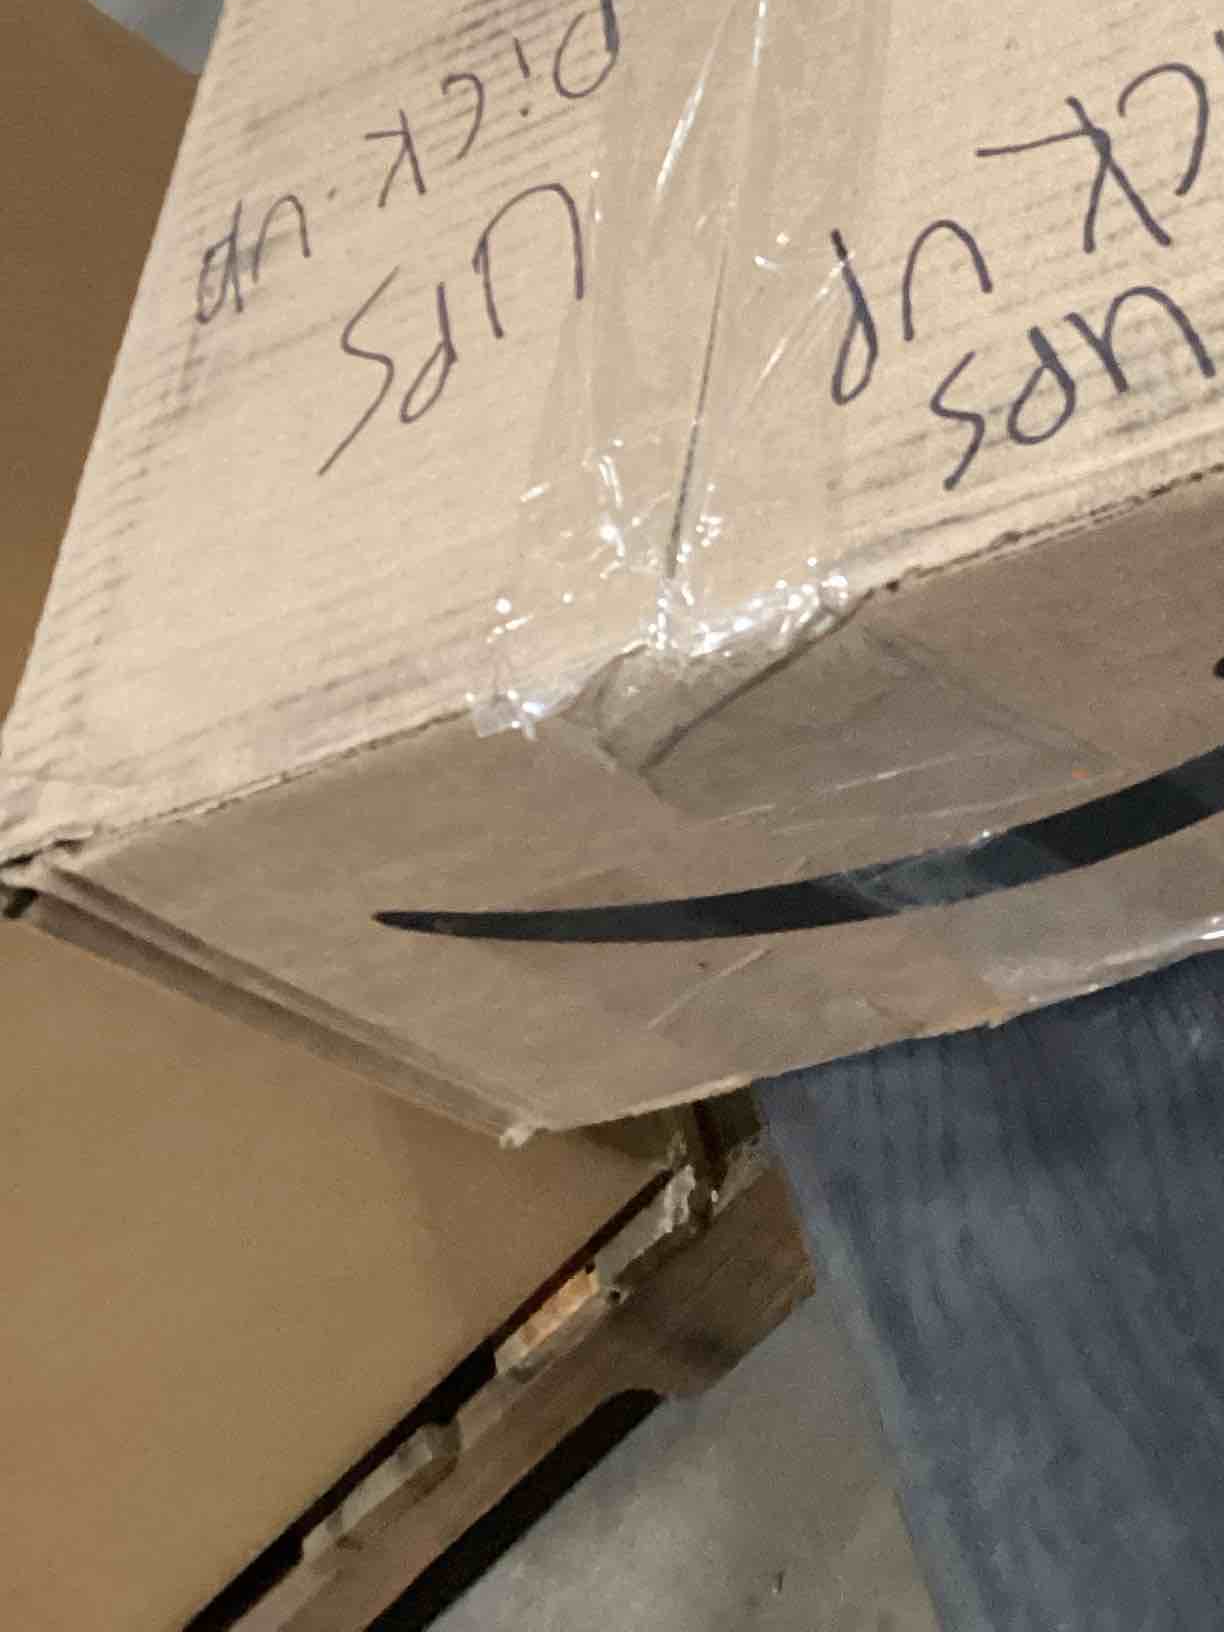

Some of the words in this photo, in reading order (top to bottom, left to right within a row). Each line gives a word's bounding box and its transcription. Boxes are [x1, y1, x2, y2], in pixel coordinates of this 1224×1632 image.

[317, 182, 585, 477] UPS
[831, 218, 993, 405] UP
[930, 285, 1217, 491] UPS
